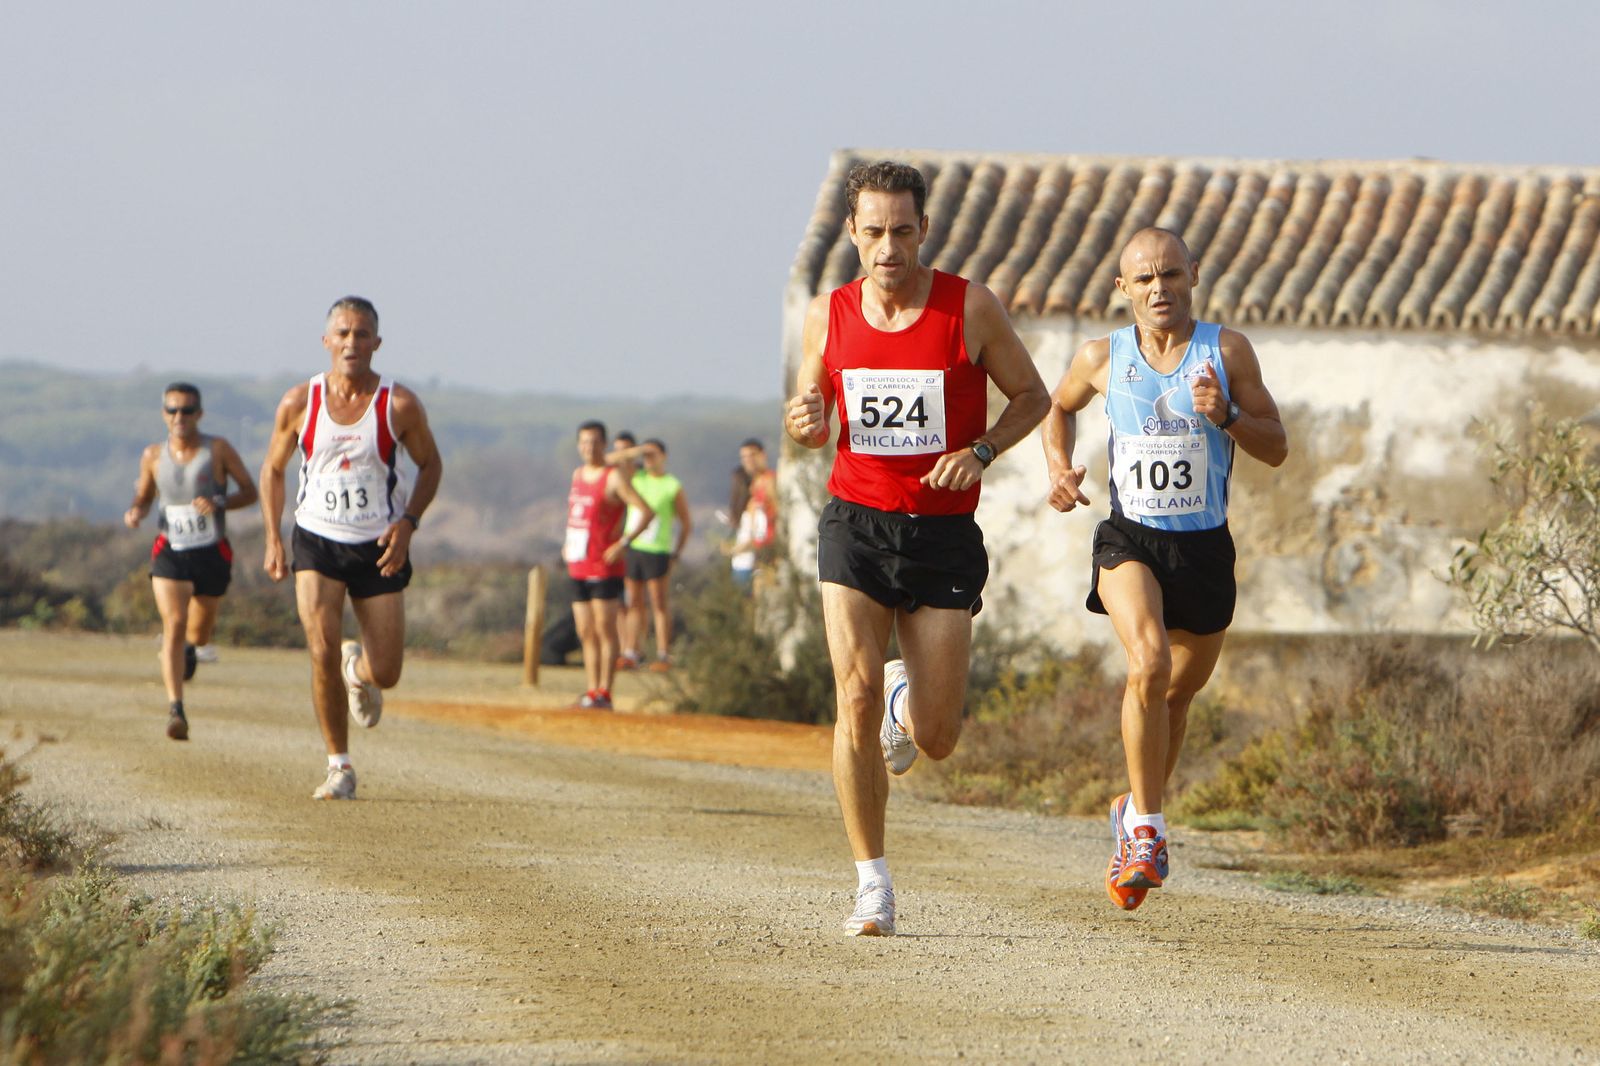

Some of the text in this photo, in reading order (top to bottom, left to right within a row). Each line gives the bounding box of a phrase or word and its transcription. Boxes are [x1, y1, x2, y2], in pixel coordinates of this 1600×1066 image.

[860, 396, 928, 428] 524
[852, 433, 942, 447] CHICLANA
[1129, 460, 1193, 491] 103
[325, 487, 368, 511] 913
